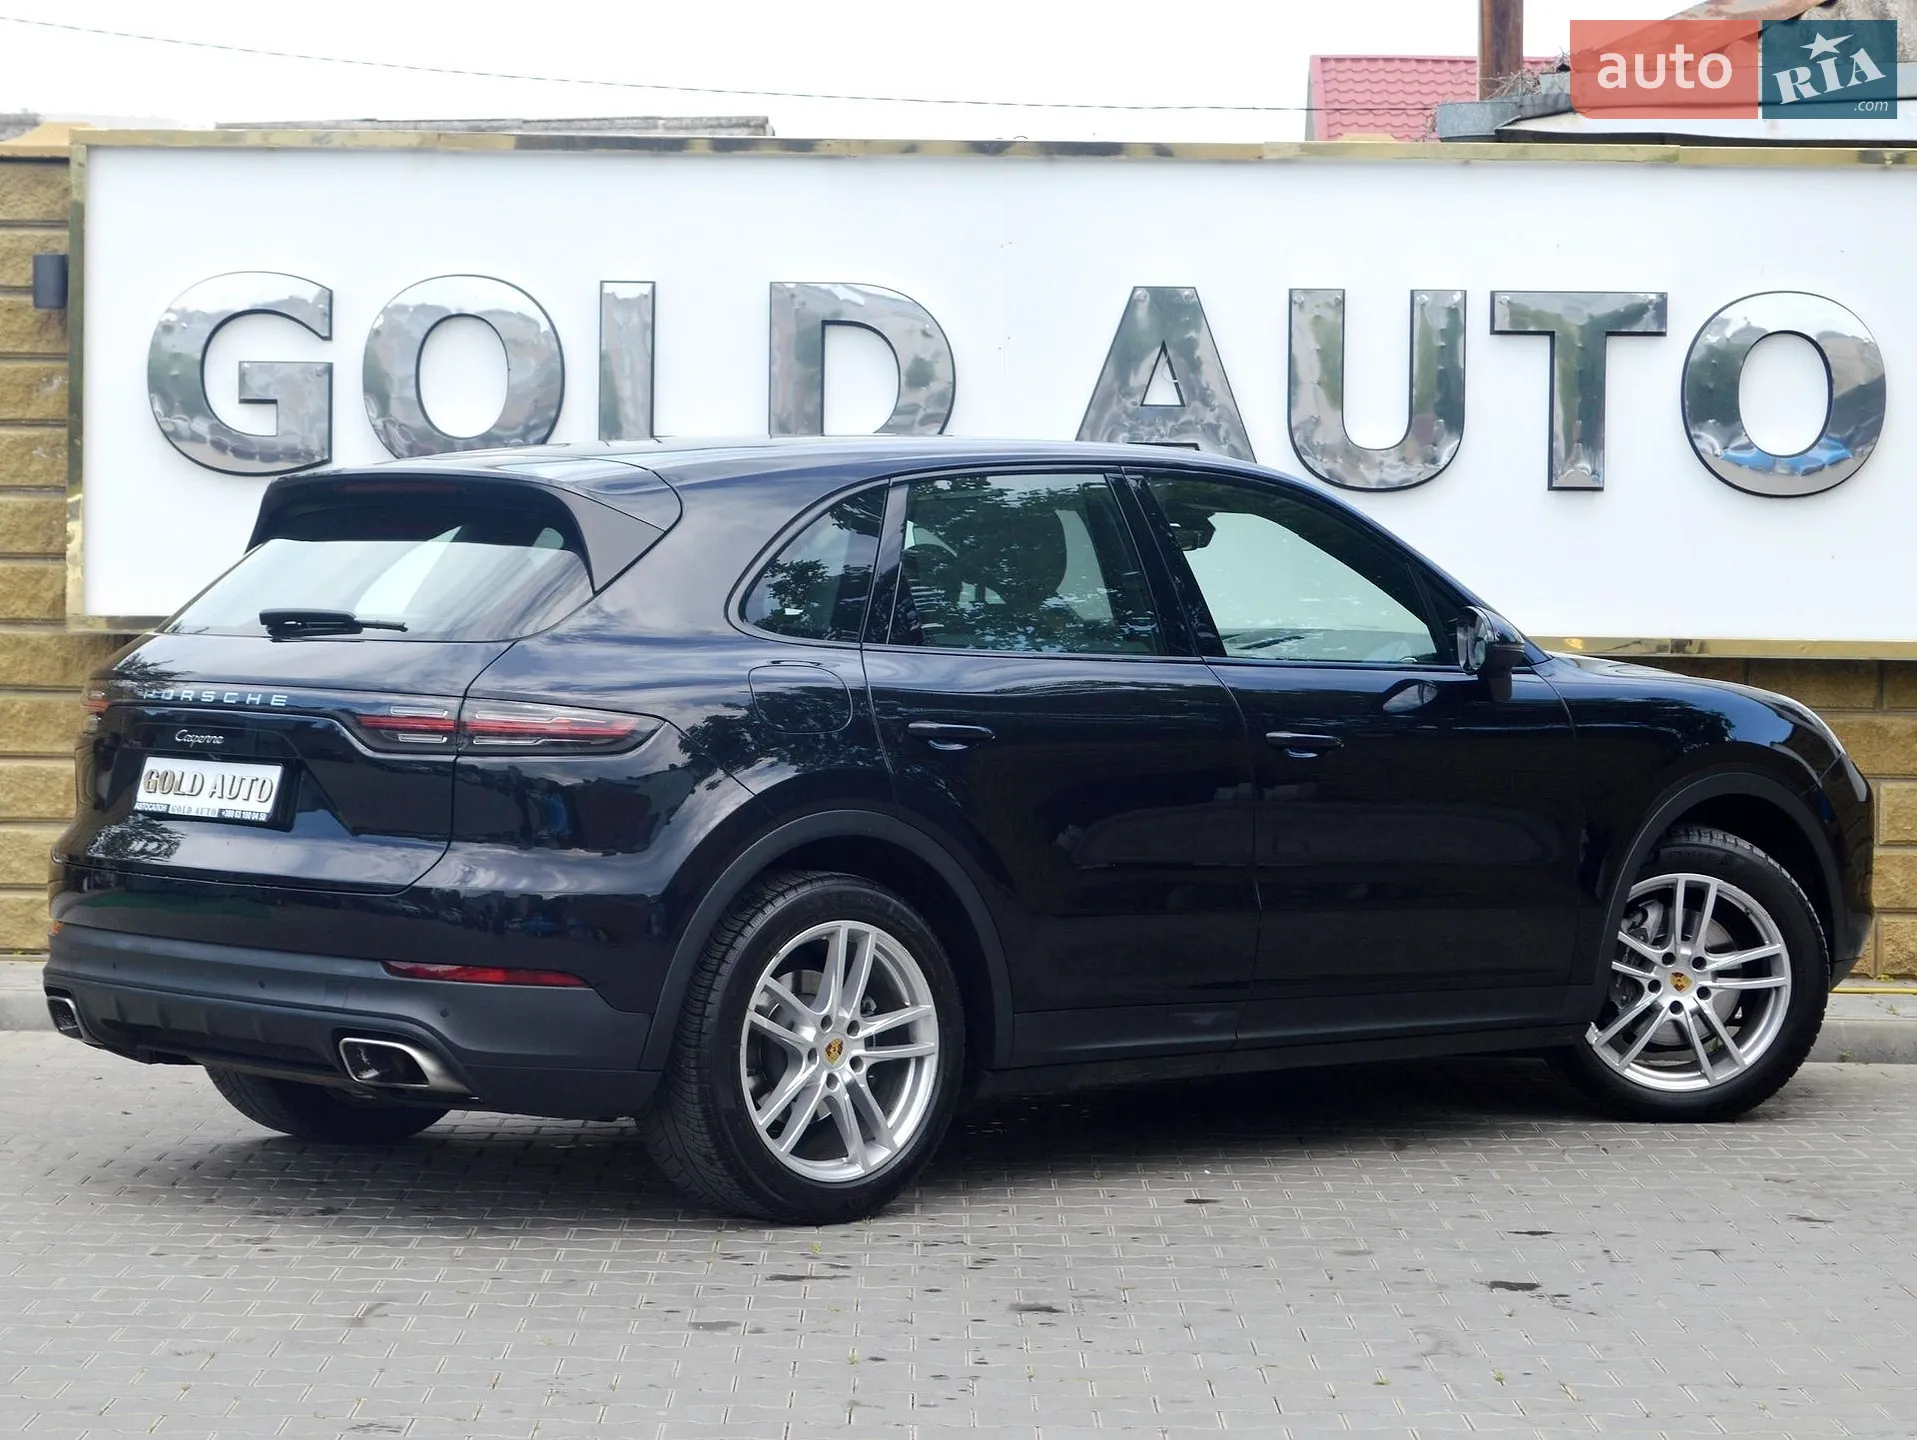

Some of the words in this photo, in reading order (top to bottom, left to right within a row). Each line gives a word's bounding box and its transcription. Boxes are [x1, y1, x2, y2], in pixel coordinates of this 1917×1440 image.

[1075, 286, 1887, 498] AUTO
[143, 689, 289, 707] PORSCHE
[175, 728, 225, 748] Cayenne
[142, 768, 205, 797] GOLD
[208, 773, 274, 804] AUTO
[170, 804, 193, 815] GOLD
[195, 806, 218, 817] AUTO
